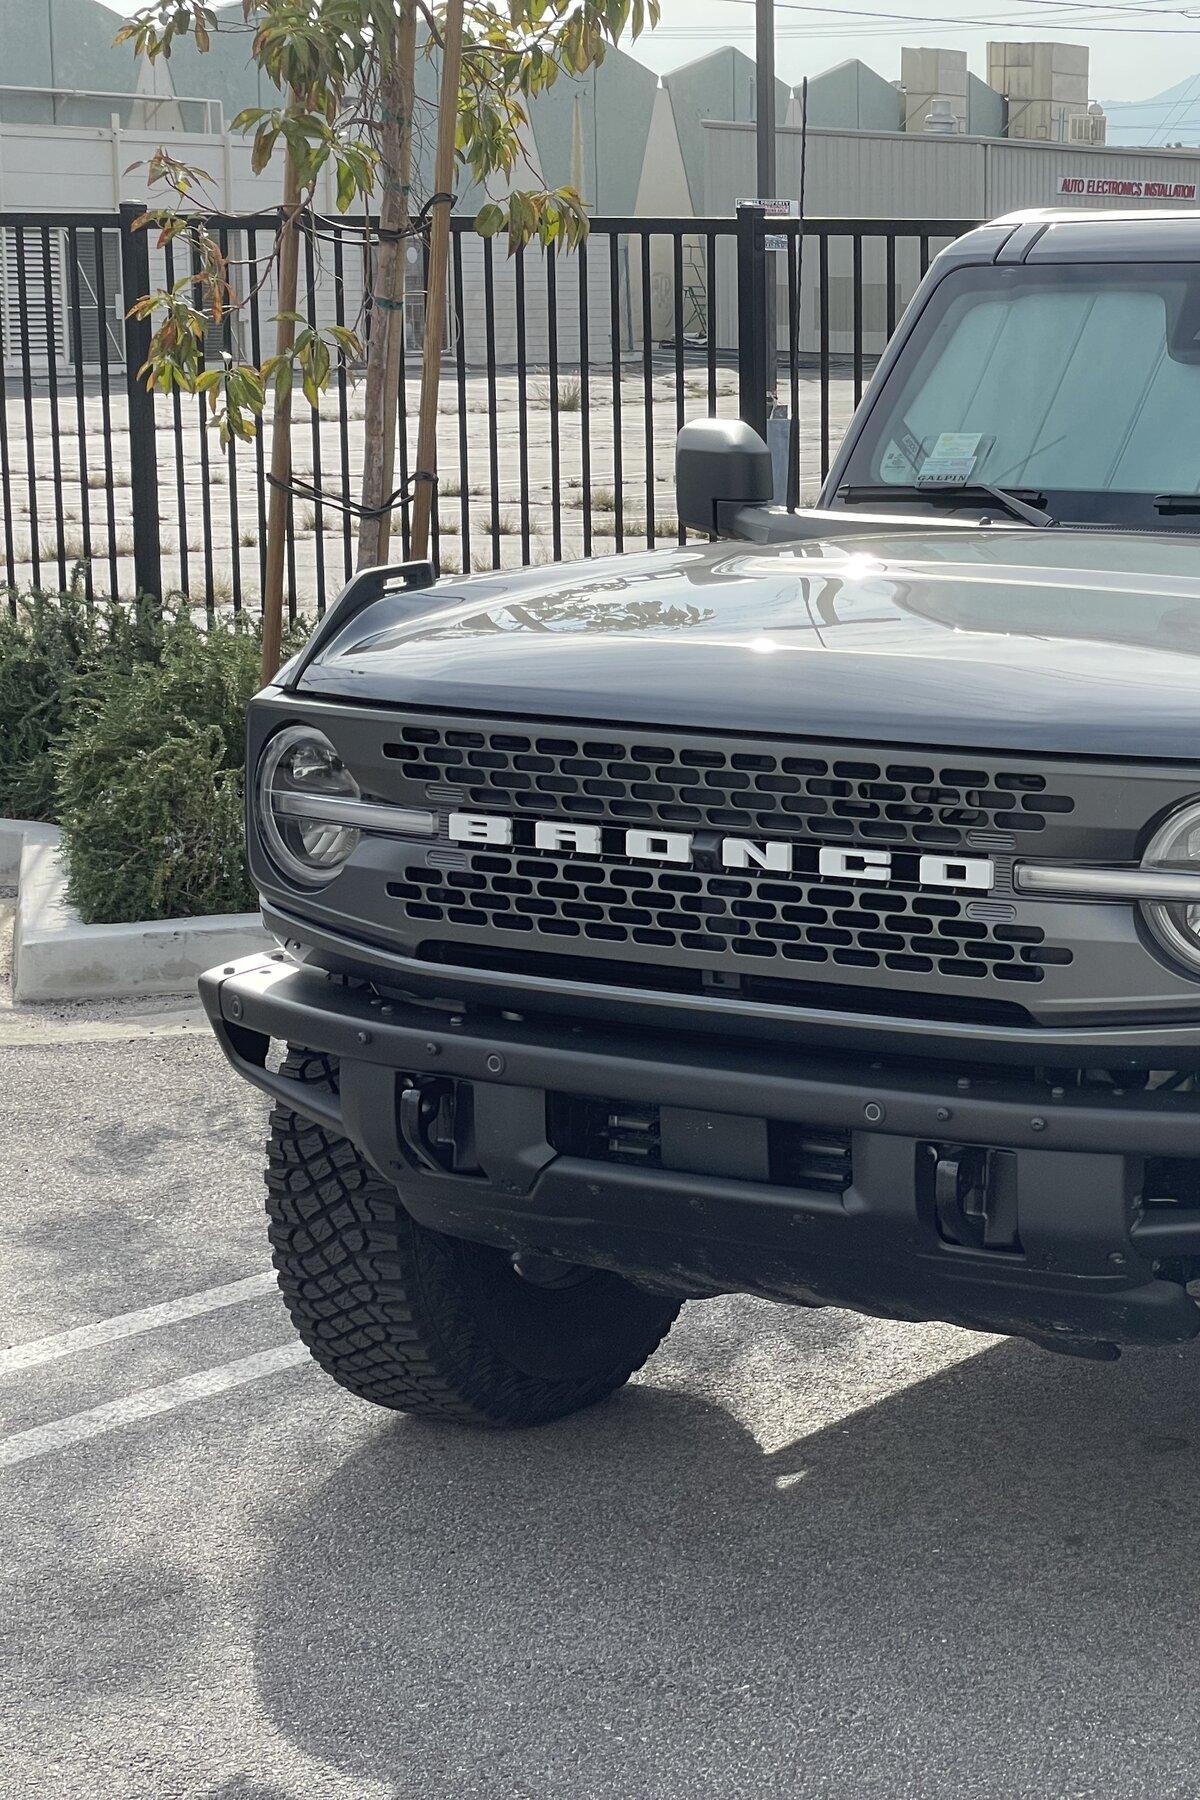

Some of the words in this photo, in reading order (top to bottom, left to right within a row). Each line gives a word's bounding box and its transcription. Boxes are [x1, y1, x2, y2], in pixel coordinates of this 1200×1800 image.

[1061, 179, 1085, 193] AUTO
[1087, 180, 1143, 196] ELECTRONICS
[1144, 182, 1196, 198] INSTALLATION
[448, 812, 994, 890] BRONCO
